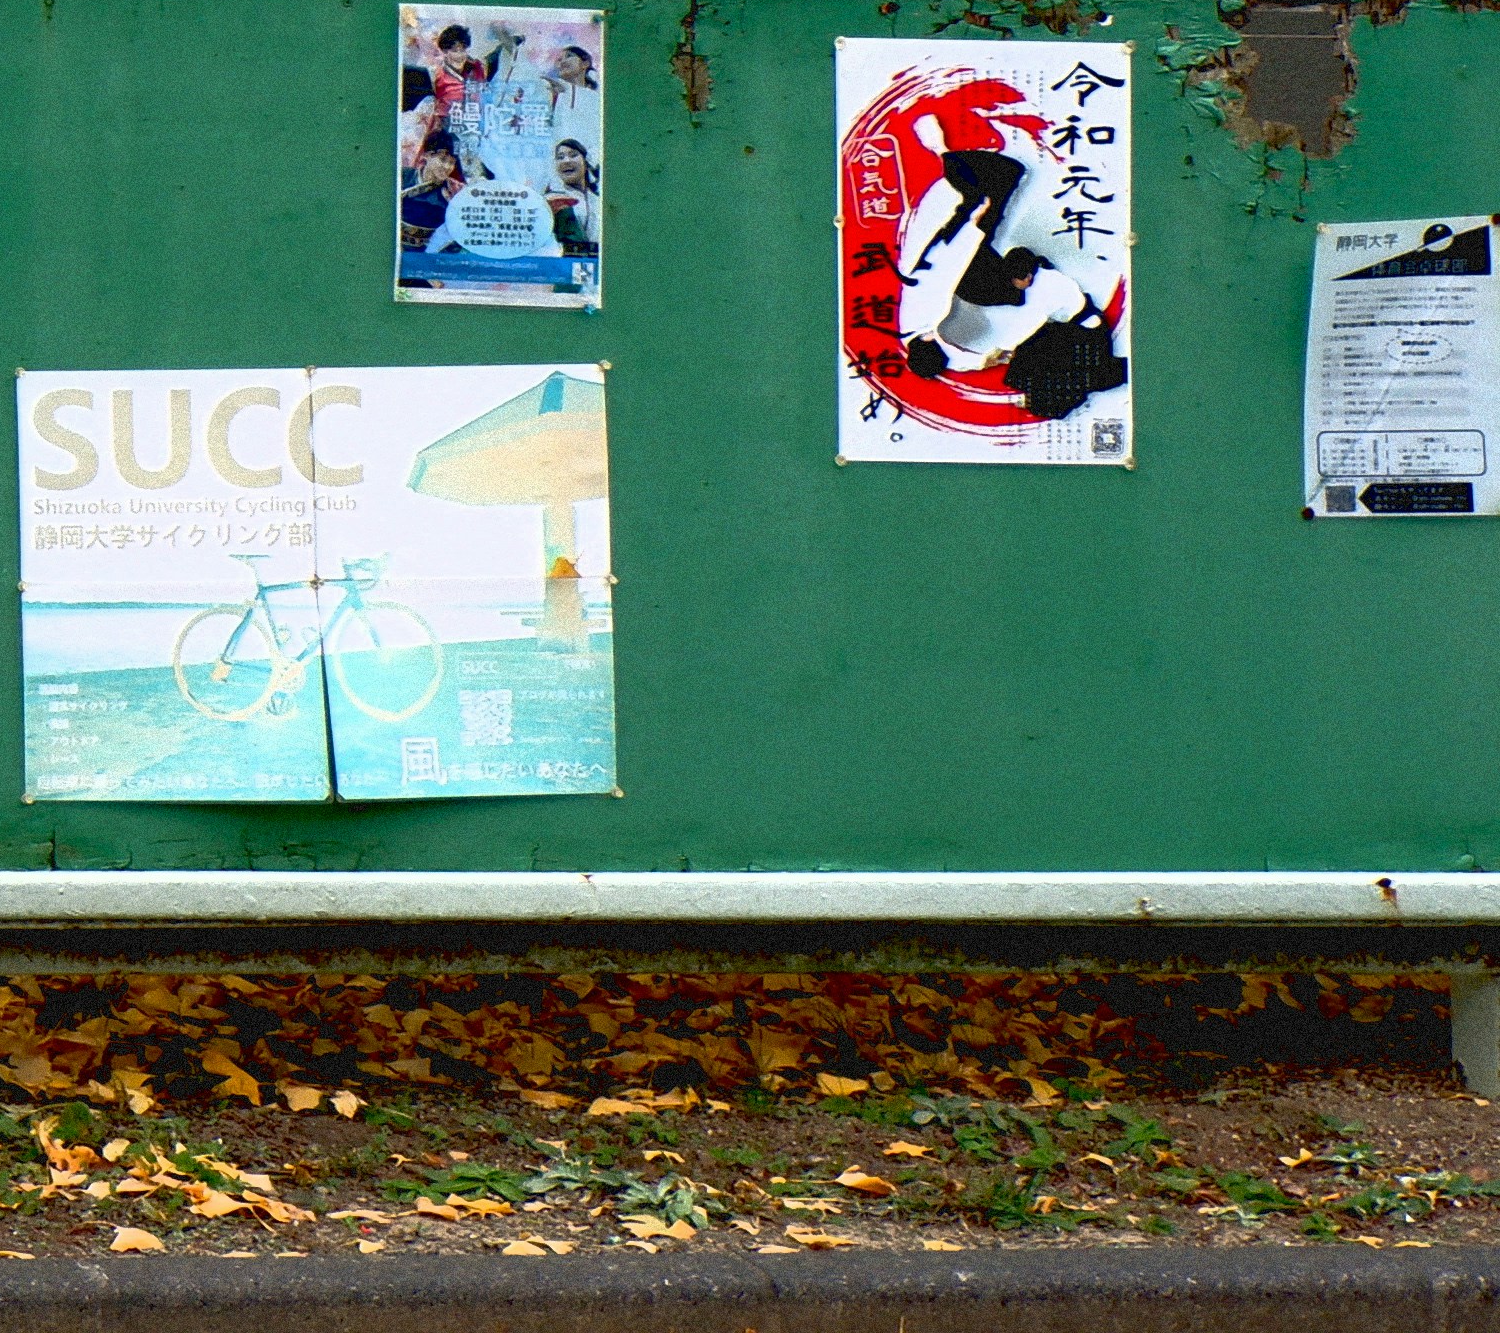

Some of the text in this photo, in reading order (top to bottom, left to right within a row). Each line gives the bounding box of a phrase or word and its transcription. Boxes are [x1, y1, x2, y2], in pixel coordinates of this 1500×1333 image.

[850, 142, 901, 220] 合気道
[1336, 233, 1399, 252] 静岡大学
[31, 383, 365, 491] SUCC
[32, 495, 358, 519] Shizuoka University Cycling Club
[33, 523, 315, 550] 静岡大学サイクリング部
